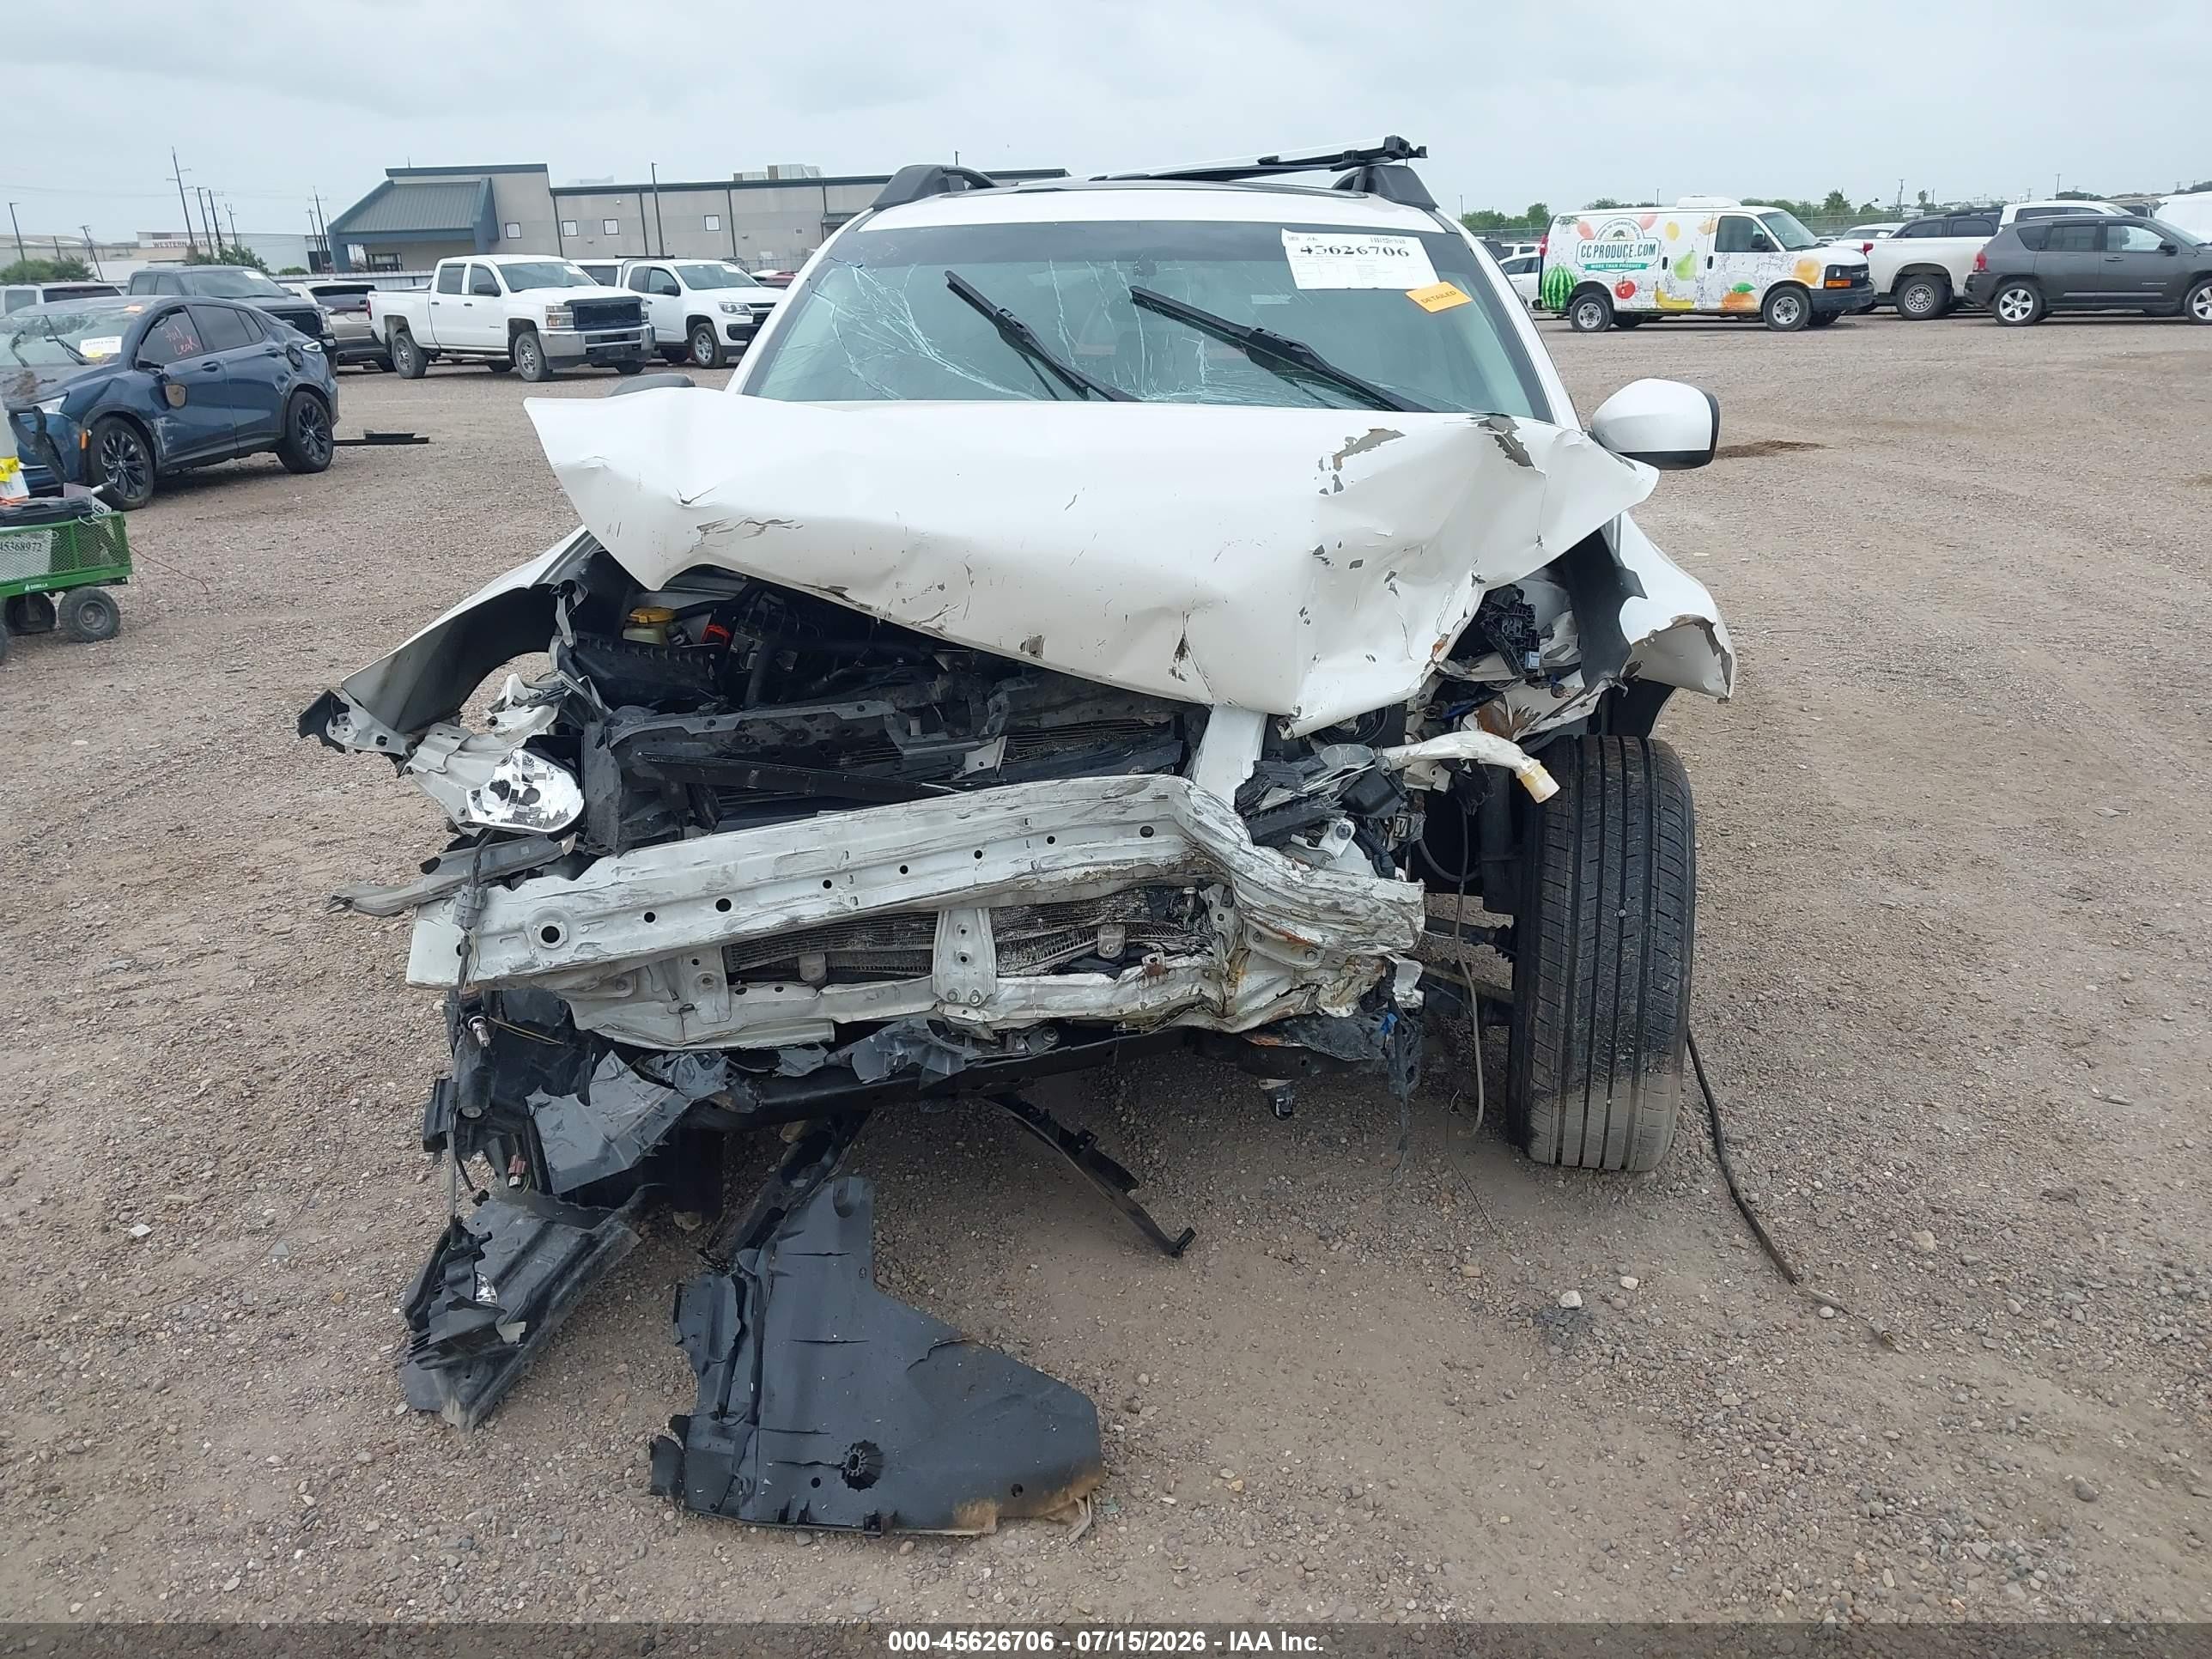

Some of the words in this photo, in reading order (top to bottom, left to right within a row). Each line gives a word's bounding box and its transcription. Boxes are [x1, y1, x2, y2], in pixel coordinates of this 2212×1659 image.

[1300, 246, 1410, 258] 45626706
[1581, 245, 1592, 258] CC
[1593, 244, 1656, 258] PRODUCE.COM
[1420, 290, 1457, 304] DETAILED
